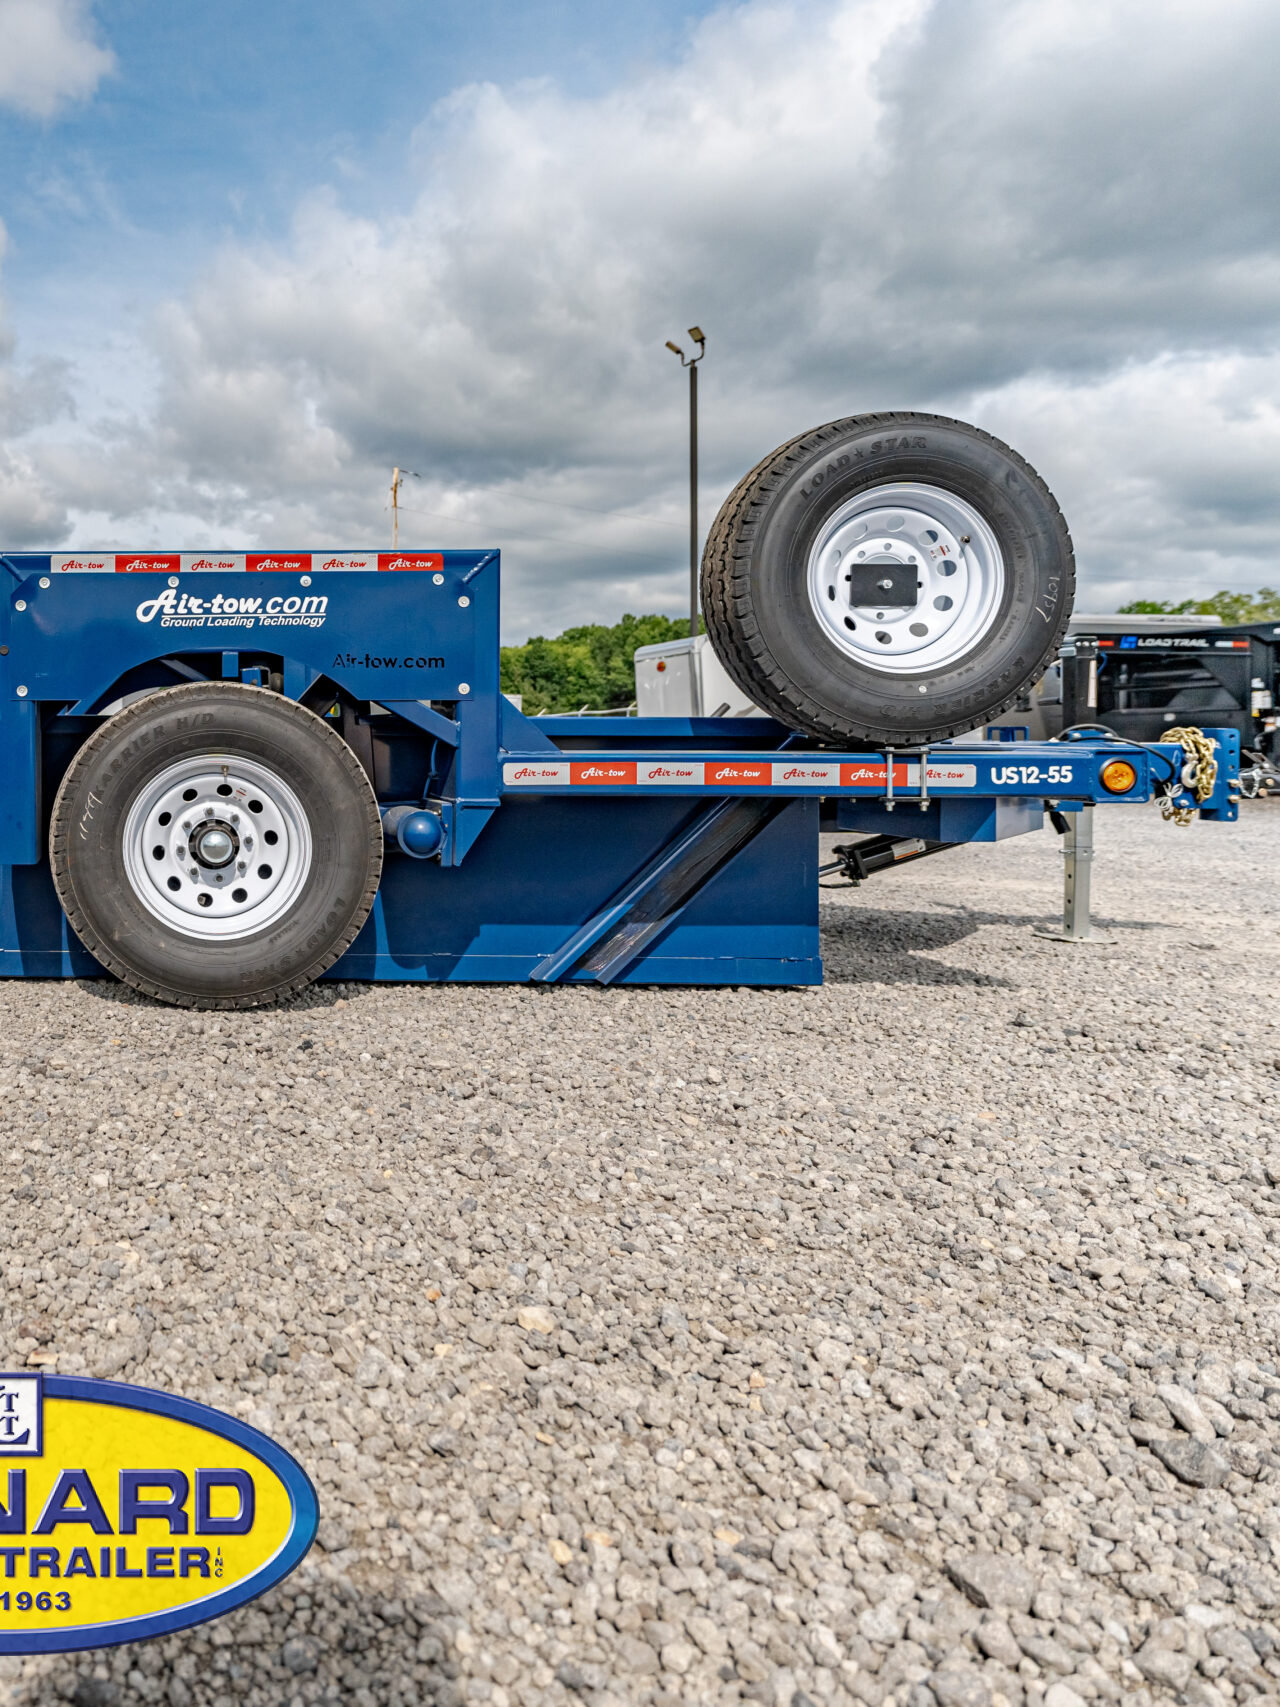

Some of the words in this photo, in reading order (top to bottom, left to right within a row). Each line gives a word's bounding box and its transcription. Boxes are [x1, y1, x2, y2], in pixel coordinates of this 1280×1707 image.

[870, 436, 927, 455] STAR
[61, 559, 105, 572] Air-tow
[125, 559, 170, 572] Air-tow
[191, 559, 235, 572] Air-tow
[256, 558, 301, 571] Air-tow
[322, 558, 367, 571] Air-tow
[388, 557, 433, 570] Air-tow
[136, 588, 328, 623] Air-tow.com
[160, 617, 202, 628] Ground
[206, 617, 255, 629] Loading
[258, 615, 326, 628] Technology
[332, 653, 445, 669] Air-tow.com
[514, 767, 559, 780] Air-tow
[580, 767, 626, 780] Air-tow
[648, 767, 693, 780] Air-tow
[715, 767, 761, 780] Air-tow
[783, 768, 829, 780] Air-tow
[990, 764, 1073, 786] US12-55
